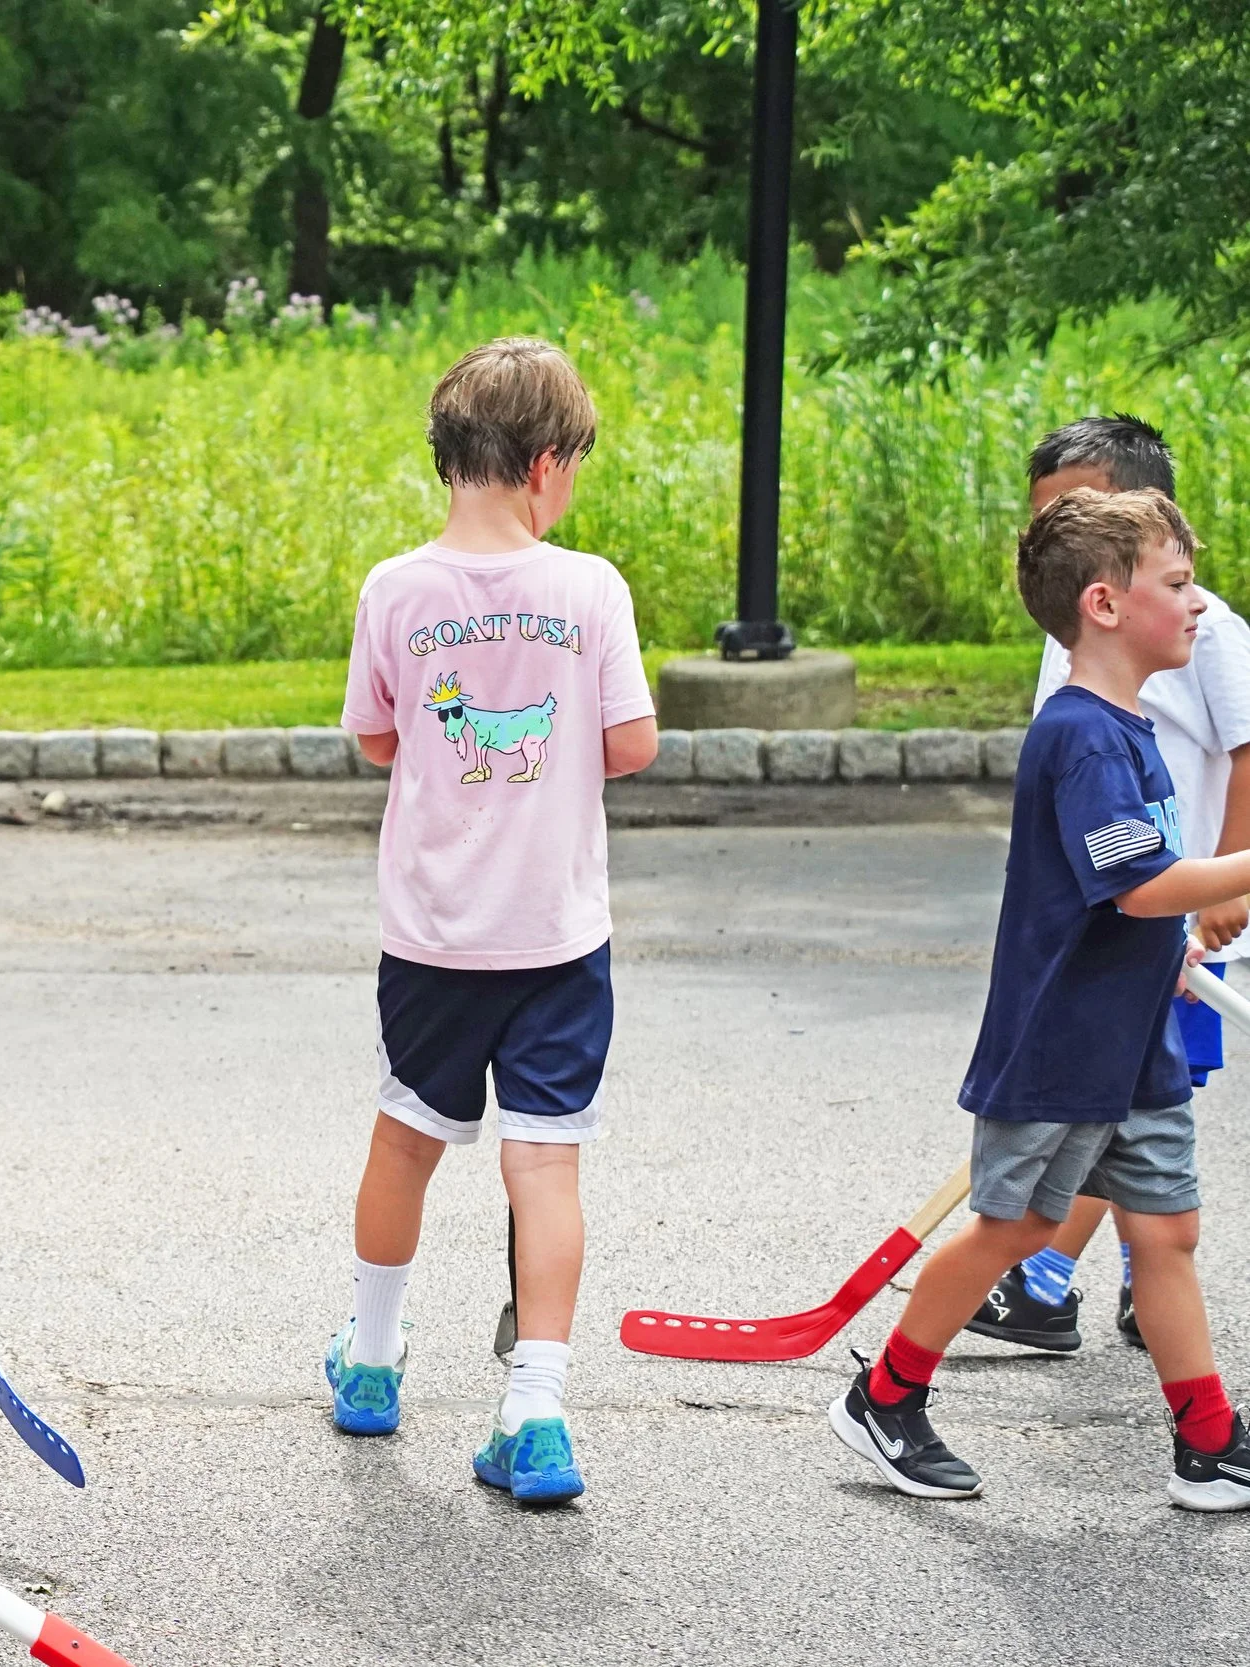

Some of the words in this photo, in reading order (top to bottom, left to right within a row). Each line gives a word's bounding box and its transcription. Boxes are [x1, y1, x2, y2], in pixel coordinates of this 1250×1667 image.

[408, 613, 511, 657] GOAT
[517, 613, 582, 656] USA
[987, 1286, 1011, 1321] CA
